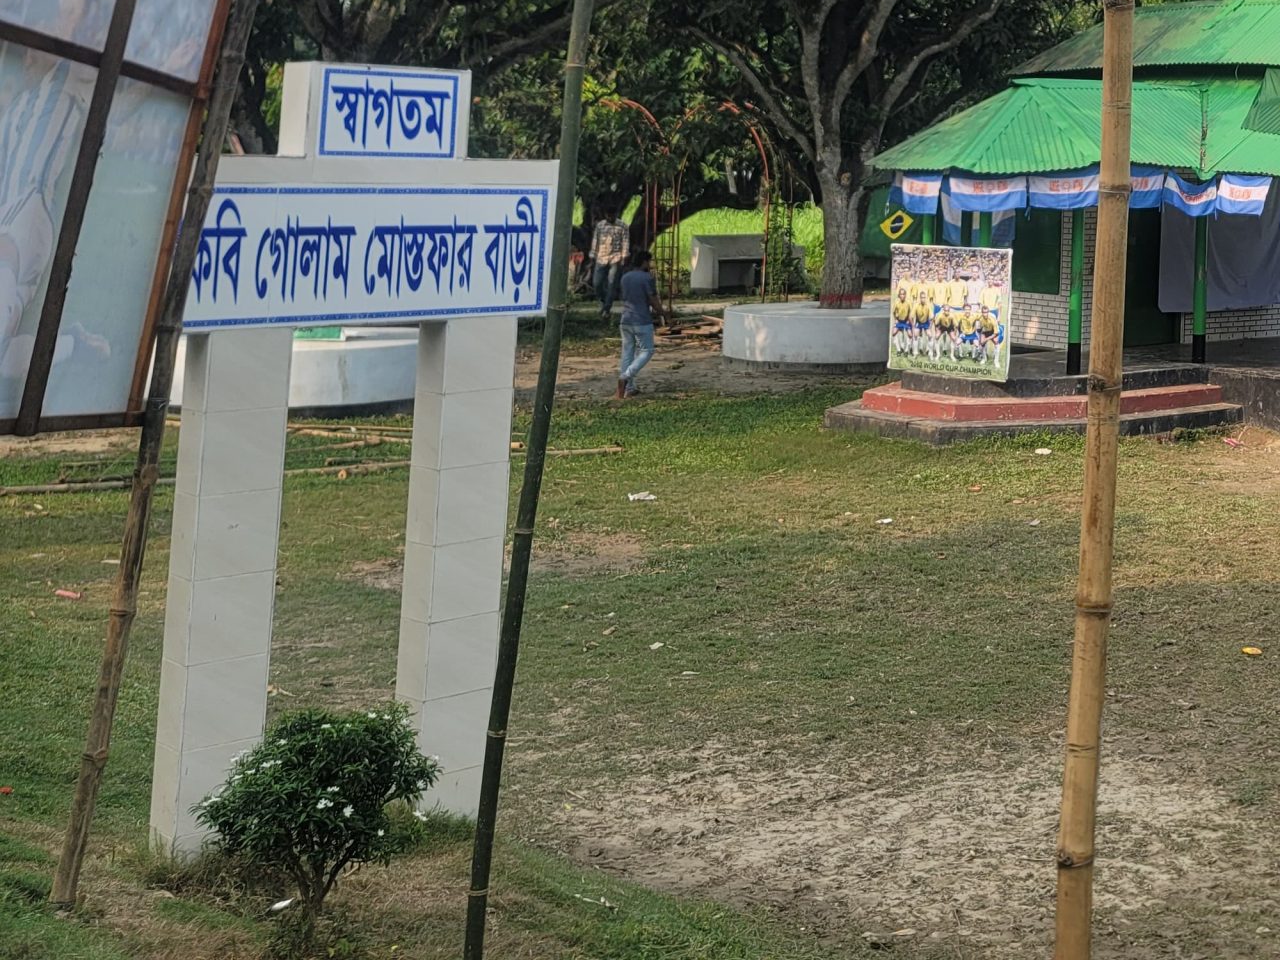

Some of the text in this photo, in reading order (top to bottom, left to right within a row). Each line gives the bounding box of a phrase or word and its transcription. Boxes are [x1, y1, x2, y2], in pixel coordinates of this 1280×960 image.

[331, 78, 451, 150] স্বাগতম
[191, 195, 539, 305] কবি গোলাম মোস্তফার বাড়ী
[924, 362, 944, 371] WORLD
[945, 364, 959, 372] CUP
[960, 366, 992, 376] CHAMPION
